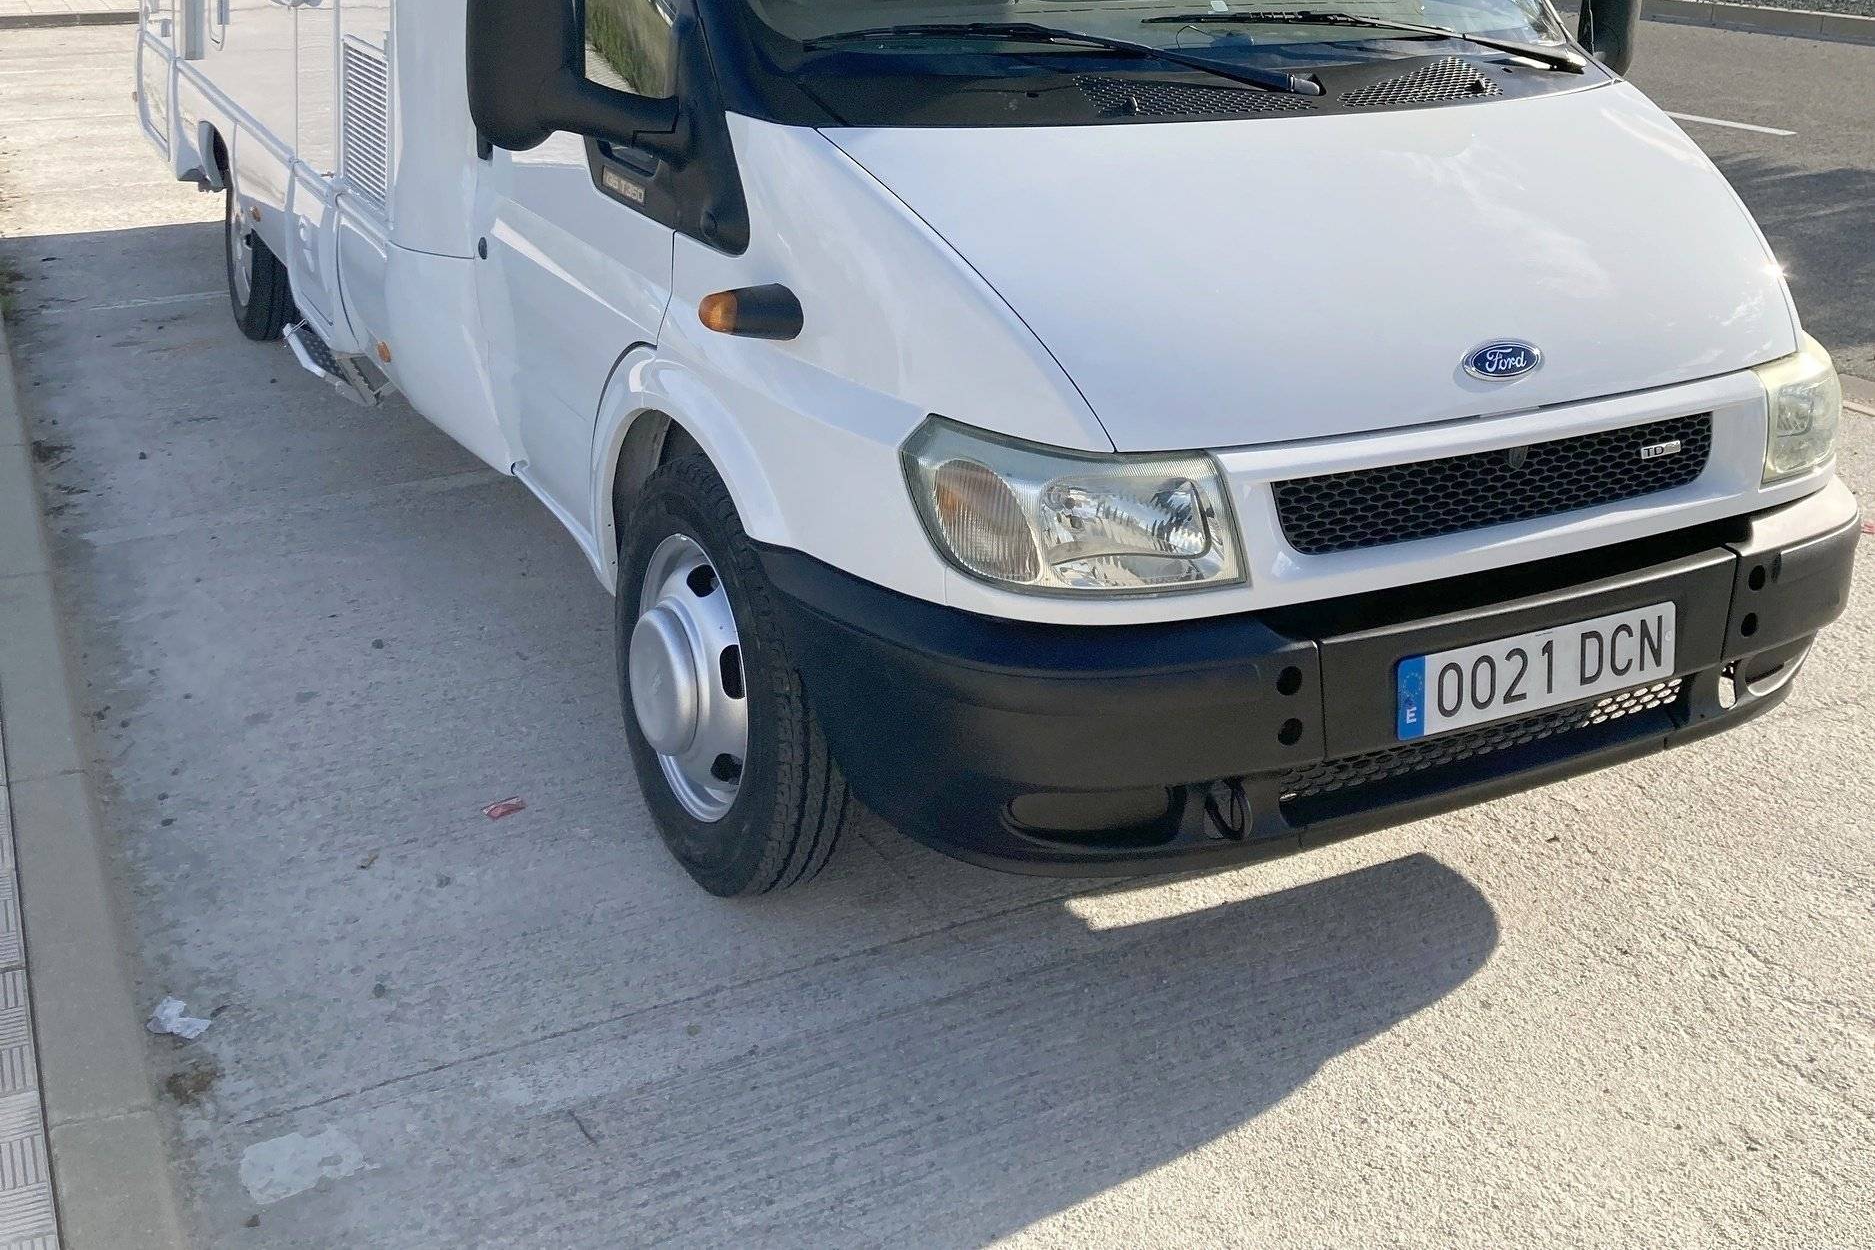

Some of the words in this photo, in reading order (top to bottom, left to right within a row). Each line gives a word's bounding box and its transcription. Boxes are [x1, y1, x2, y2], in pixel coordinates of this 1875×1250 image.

[1485, 348, 1527, 372] Ford
[1437, 639, 1554, 718] 0021
[1580, 615, 1663, 687] DCN
[1405, 706, 1417, 724] E
